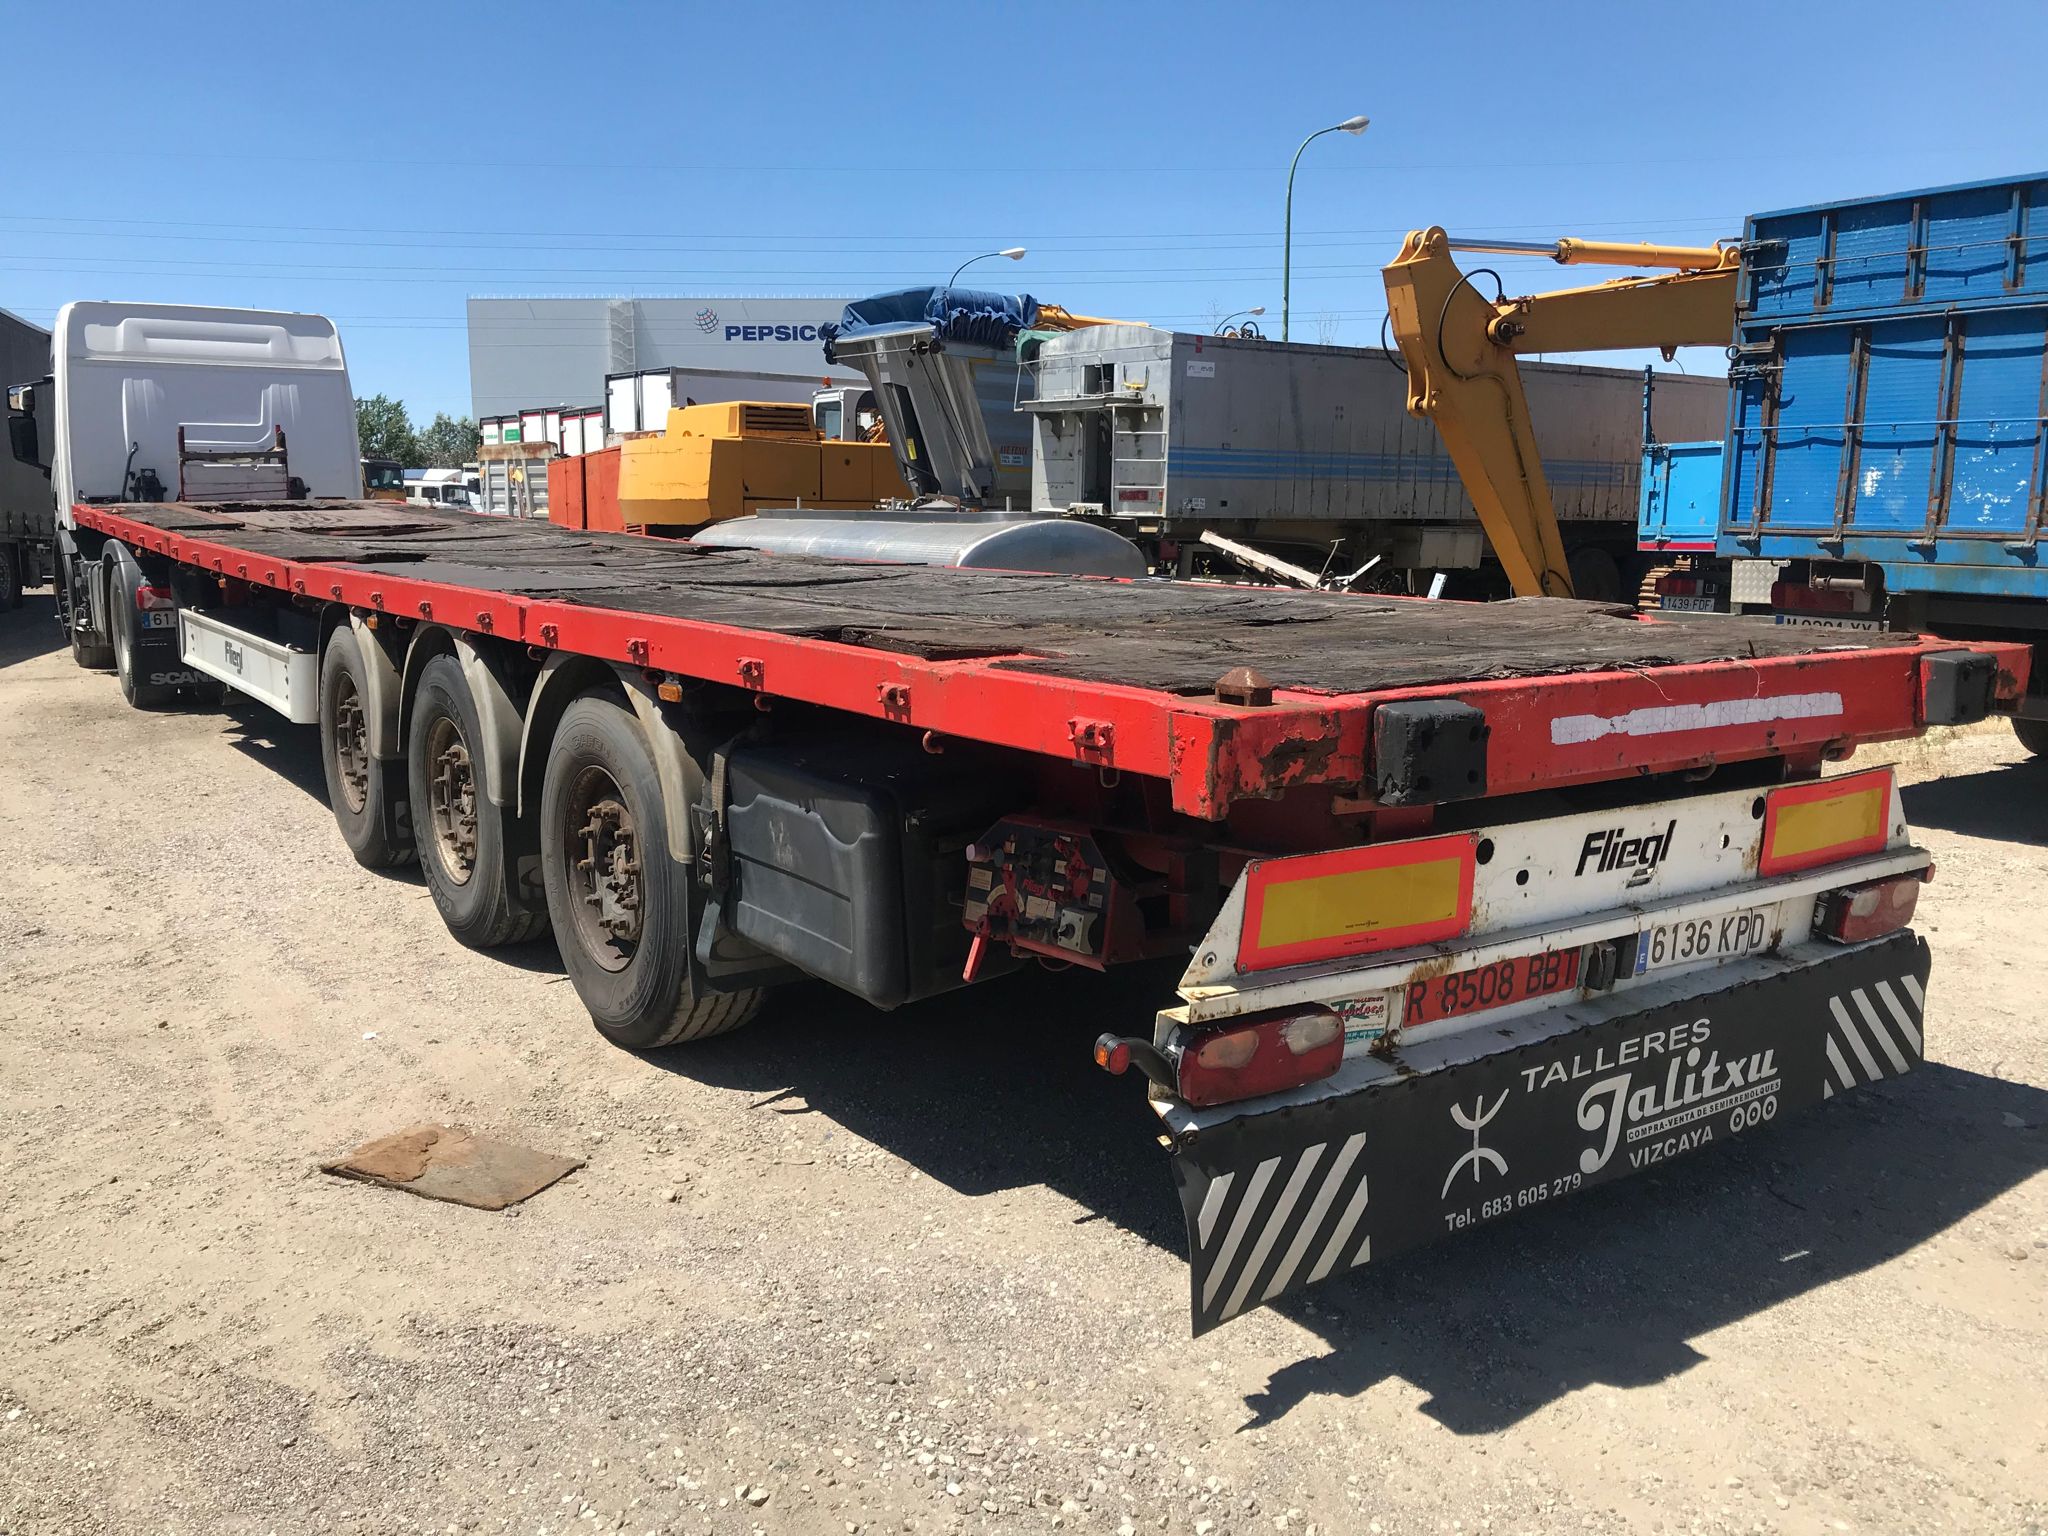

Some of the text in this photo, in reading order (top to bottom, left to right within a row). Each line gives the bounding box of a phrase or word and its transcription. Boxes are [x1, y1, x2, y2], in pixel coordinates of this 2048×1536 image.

[1668, 598, 1711, 610] 1439 FDF
[150, 671, 216, 686] SCAN
[225, 641, 243, 675] Fliegl
[1575, 820, 1677, 889] Fliegl
[1640, 953, 1646, 965] E
[1652, 913, 1765, 963] 6136 KPD
[1406, 949, 1580, 1022] R 8508 BBT
[1521, 1018, 1711, 1093] TALLERES
[1577, 1047, 1778, 1174] Jalitxu
[1628, 1081, 1780, 1140] COMPRA-VENTA DE SEMIRREMOLQUES
[1629, 1126, 1713, 1169] VIZCAYA
[1445, 1172, 1582, 1231] Tel. 683 605 279
